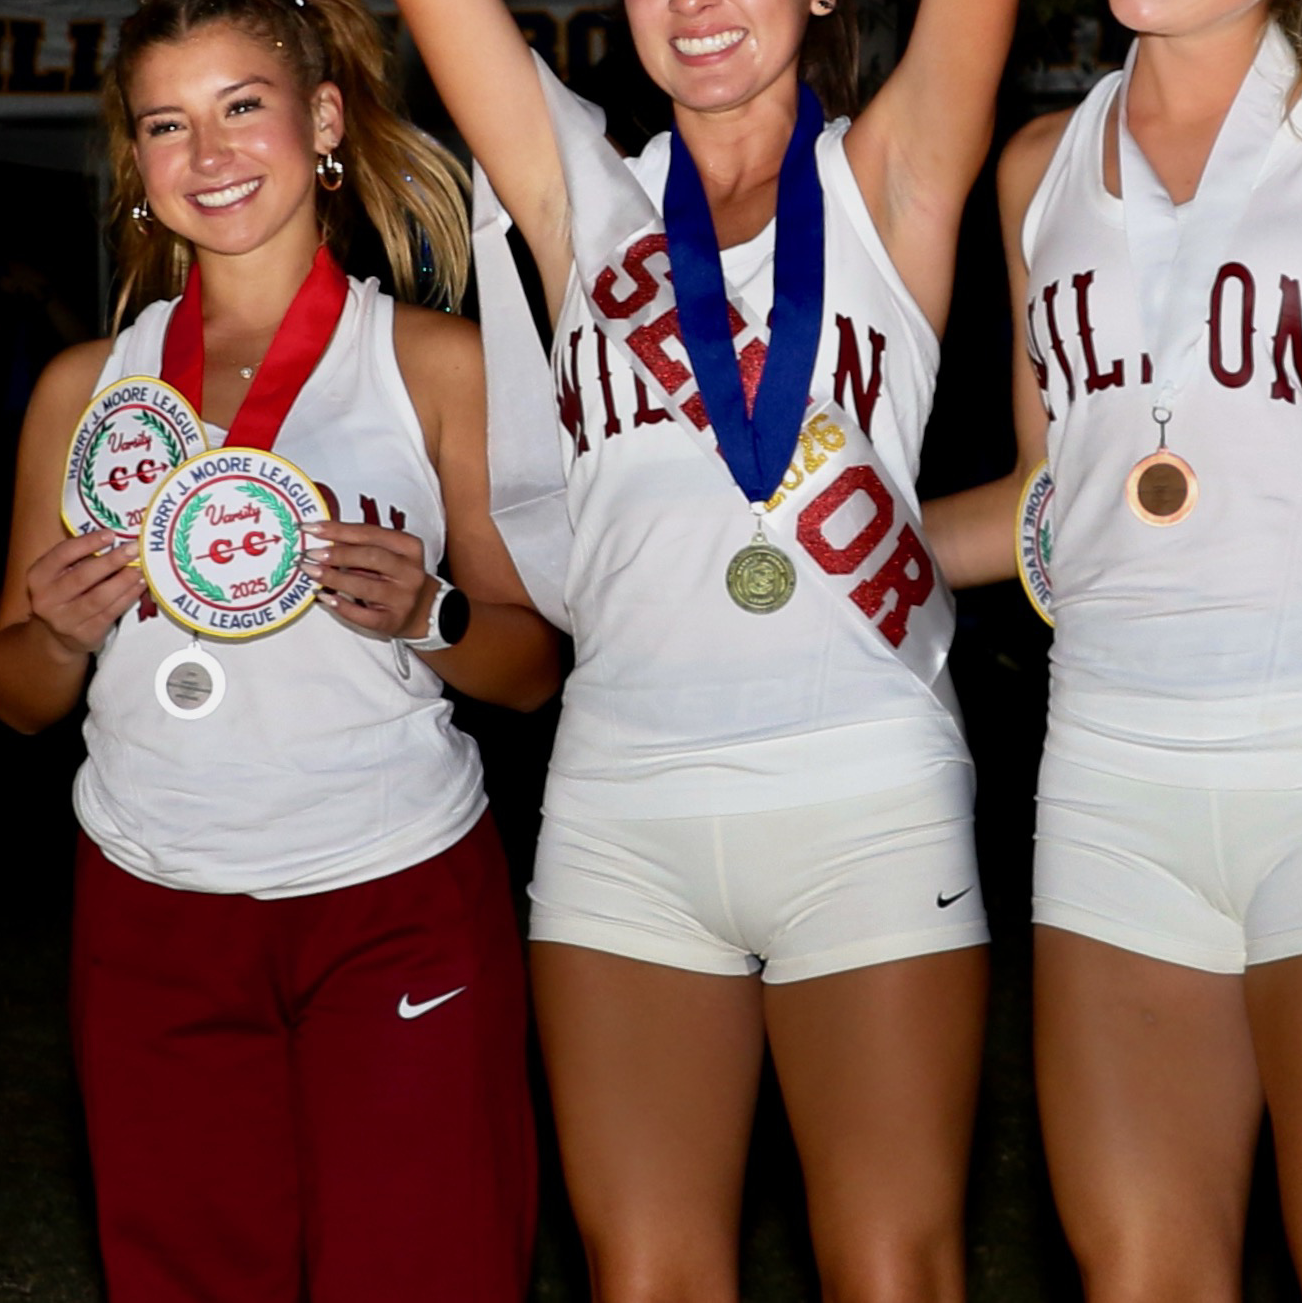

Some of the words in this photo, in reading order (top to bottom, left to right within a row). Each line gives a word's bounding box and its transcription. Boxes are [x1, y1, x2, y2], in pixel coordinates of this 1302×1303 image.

[552, 312, 887, 458] WILN
[68, 422, 93, 480] HARRY
[102, 387, 148, 412] MOORE
[152, 390, 198, 445] LEAGUE
[107, 430, 152, 454] Varsity
[125, 506, 149, 527] 20
[149, 493, 178, 552] HARRY
[190, 457, 252, 483] MOORE
[259, 462, 318, 517] LEAGUE
[205, 502, 261, 526] Varsity
[173, 594, 201, 621] ALL
[209, 607, 276, 629] LEAGUE
[279, 572, 314, 614] AWAR
[230, 577, 268, 600] 2025
